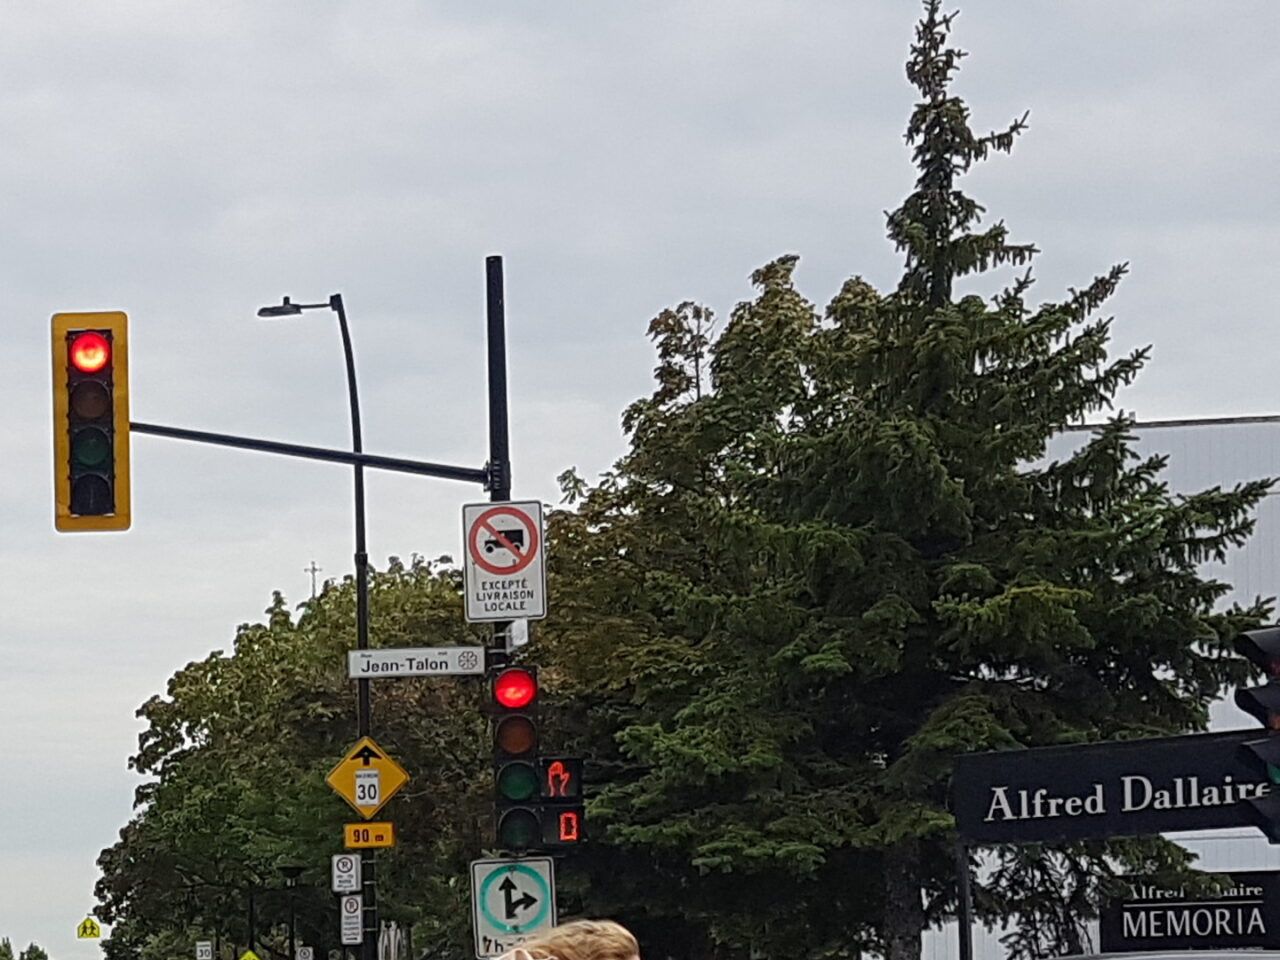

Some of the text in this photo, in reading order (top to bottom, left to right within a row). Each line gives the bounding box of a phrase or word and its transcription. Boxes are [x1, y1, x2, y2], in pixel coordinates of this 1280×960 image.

[481, 577, 528, 591] EXCEPTÉ
[476, 590, 534, 602] LIVRAISON
[484, 601, 527, 612] LOCALE
[361, 657, 449, 673] Jean-Talon
[357, 784, 378, 801] 30
[983, 775, 1272, 822] Alfred Dallaire
[353, 828, 370, 843] 90
[1123, 907, 1267, 938] MEMORIA
